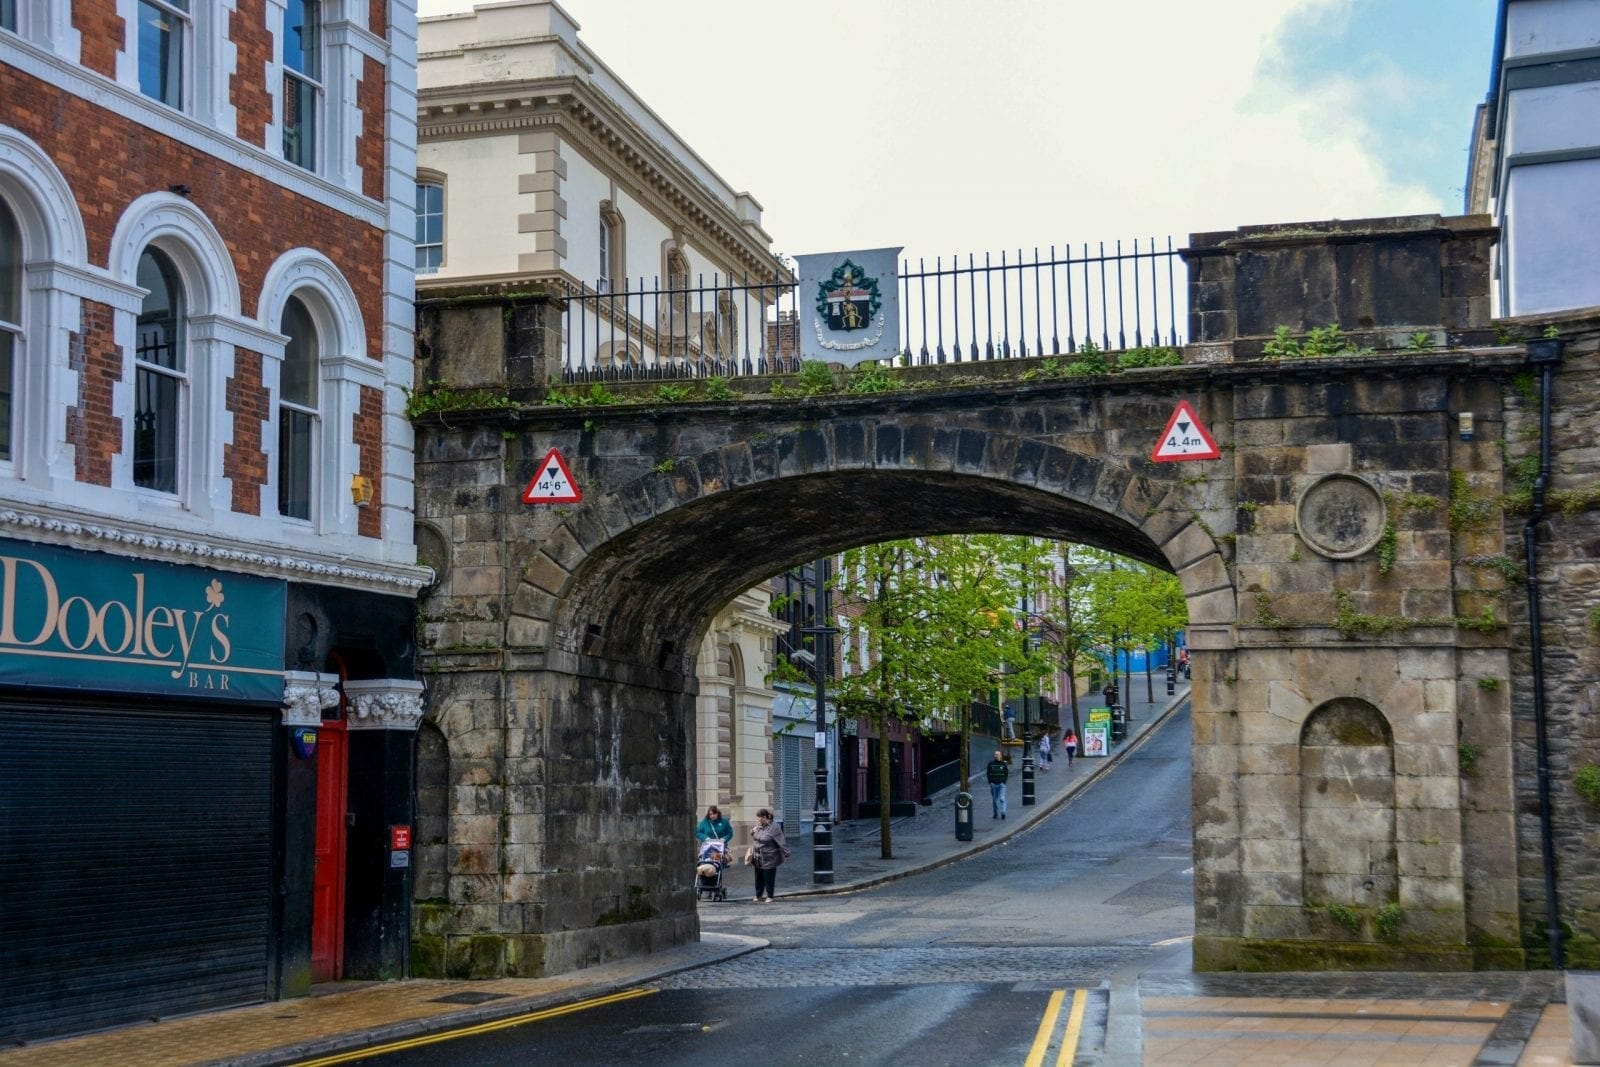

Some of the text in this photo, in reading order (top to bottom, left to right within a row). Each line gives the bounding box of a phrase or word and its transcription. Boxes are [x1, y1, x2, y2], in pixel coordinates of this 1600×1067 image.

[1167, 436, 1201, 447] 4.4m
[0, 556, 231, 679] Dooley's
[189, 671, 229, 690] BAR
